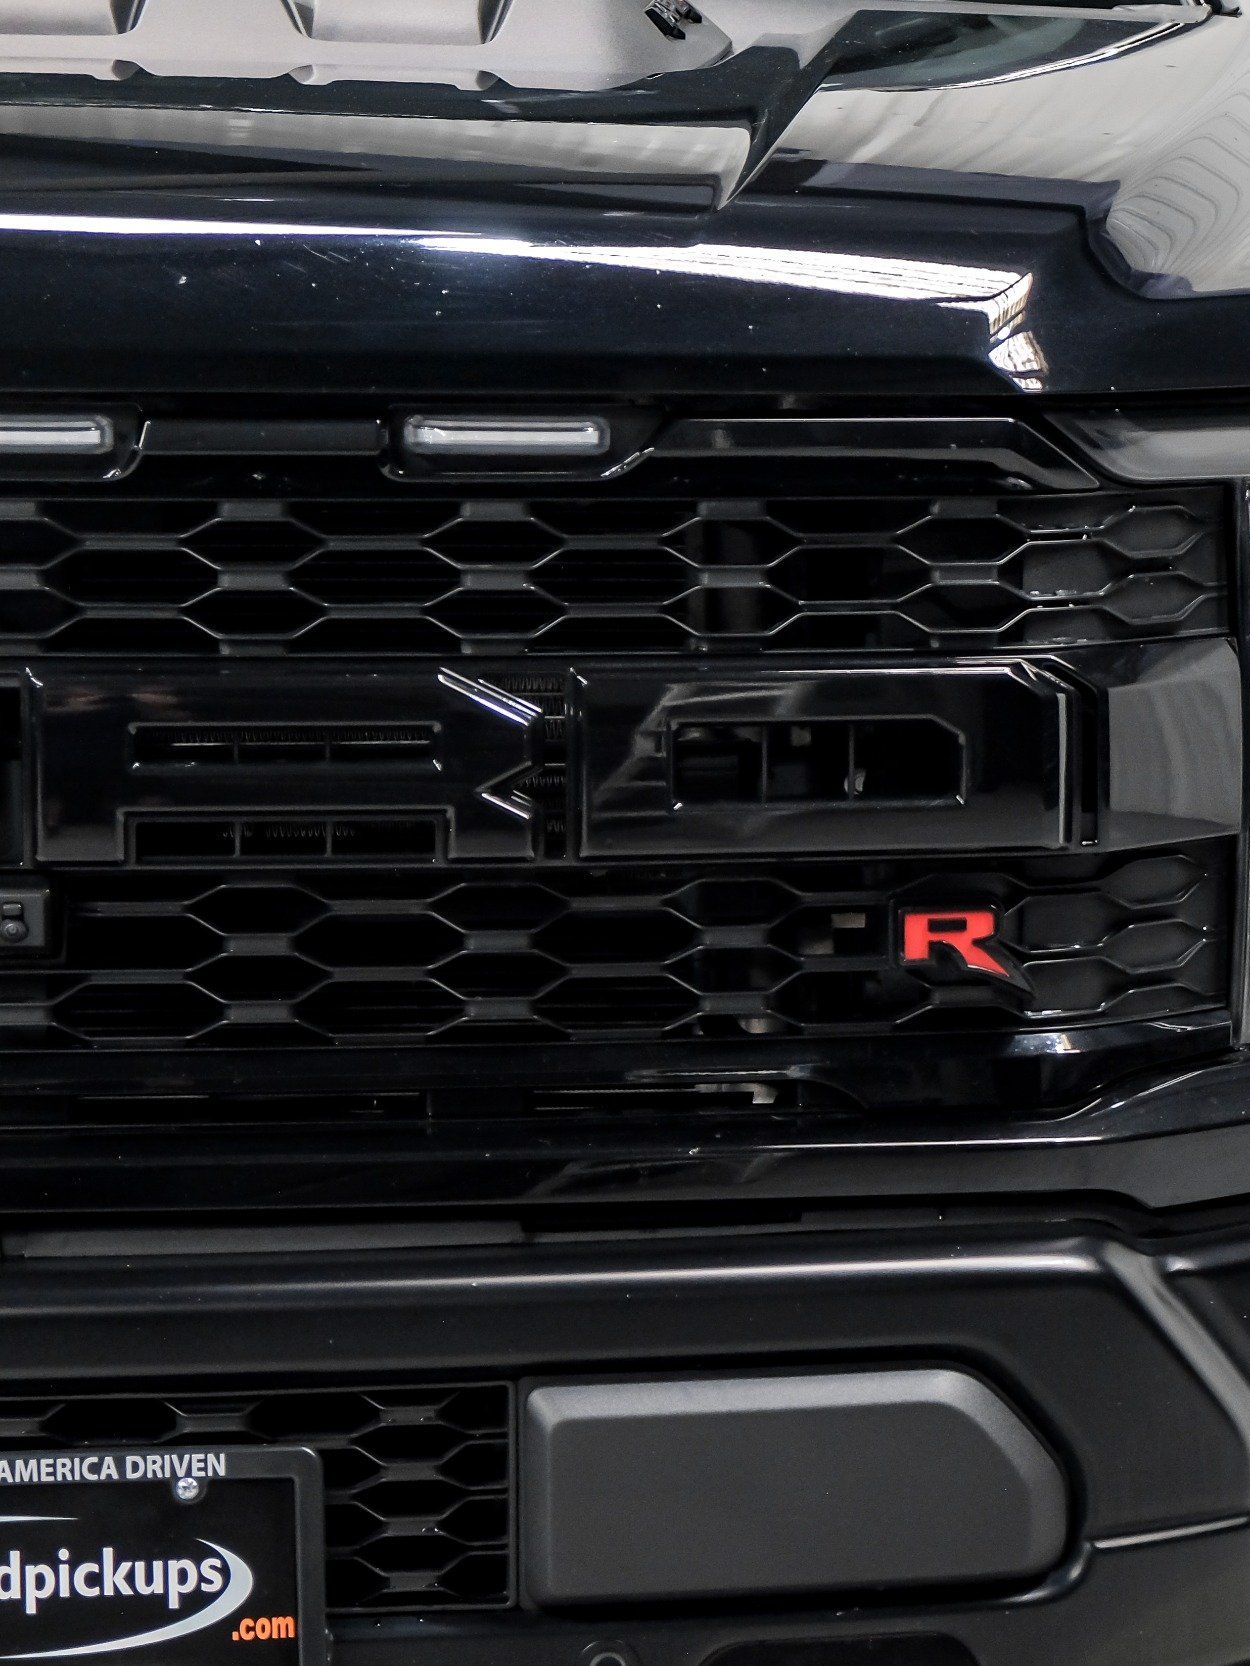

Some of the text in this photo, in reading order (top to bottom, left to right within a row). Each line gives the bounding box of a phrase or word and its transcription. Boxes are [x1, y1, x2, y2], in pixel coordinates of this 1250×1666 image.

[904, 911, 1010, 977] R
[0, 1453, 226, 1483] AMERICA DRIVEN
[231, 1615, 295, 1641] .com
